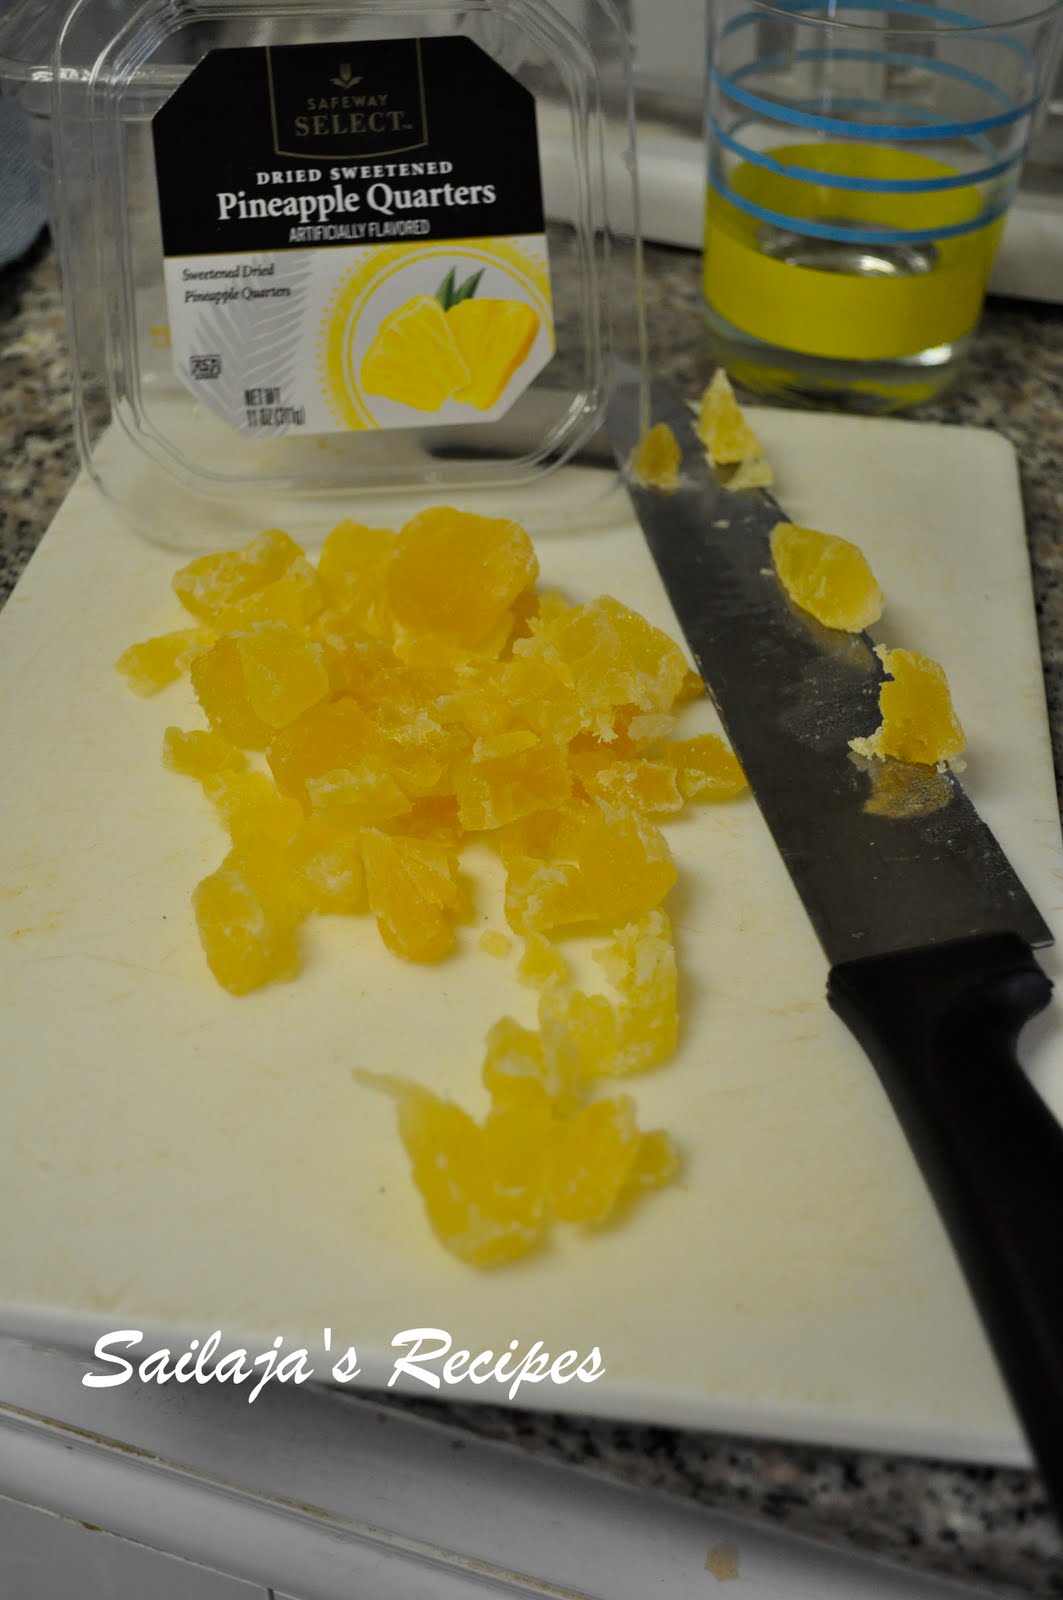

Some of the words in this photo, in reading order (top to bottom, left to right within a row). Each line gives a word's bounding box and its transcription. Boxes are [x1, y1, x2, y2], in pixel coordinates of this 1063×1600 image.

[307, 94, 388, 111] SAFEWAY
[295, 110, 405, 136] SELECT
[256, 167, 322, 185] DRIED
[330, 160, 453, 182] SWEETENED
[216, 184, 360, 222] Pineapple
[366, 181, 497, 214] Quarters
[288, 222, 367, 242] ARTIFICIALLY
[367, 218, 431, 238] FLAVORED
[242, 263, 275, 279] Dried
[185, 288, 239, 304] Pineapple
[241, 287, 291, 301] Quarters
